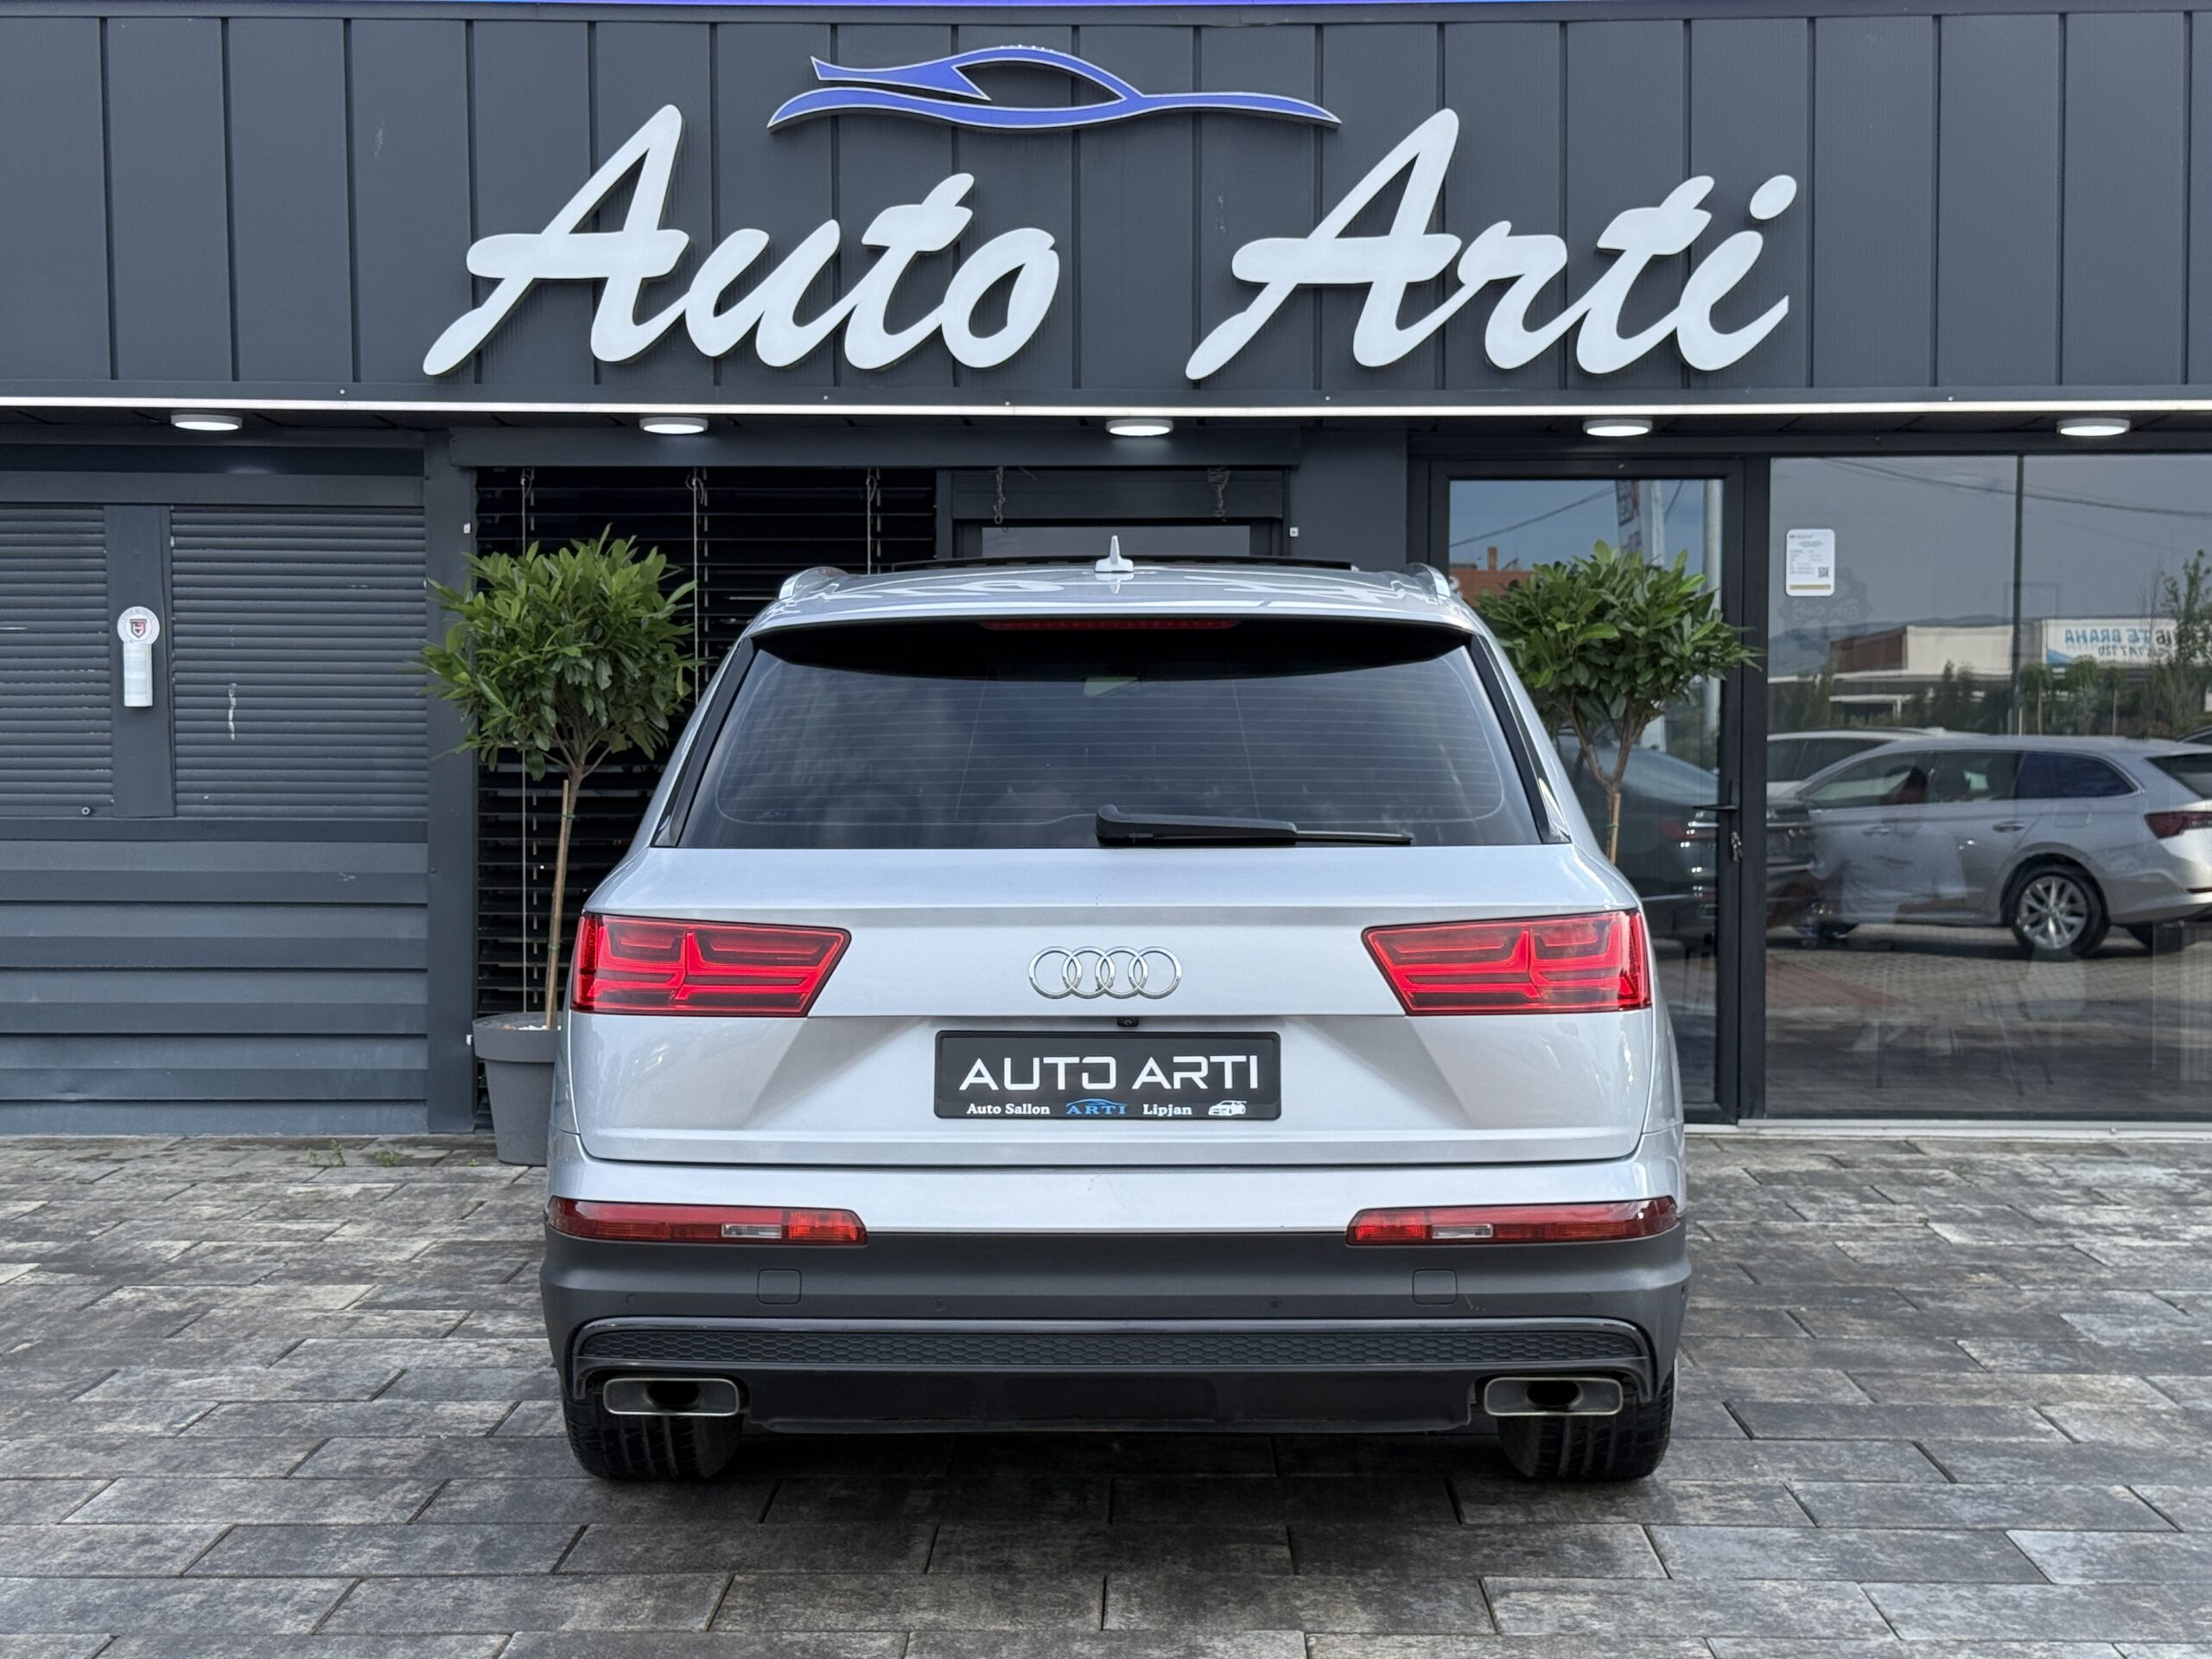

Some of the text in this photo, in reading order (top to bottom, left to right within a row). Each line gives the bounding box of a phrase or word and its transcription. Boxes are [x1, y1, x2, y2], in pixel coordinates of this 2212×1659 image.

[423, 104, 1797, 381] Auto Arti
[958, 1055, 1259, 1090] AUTO ARTI
[966, 1103, 1193, 1117] Auto Sallon ARTI Lipjan
